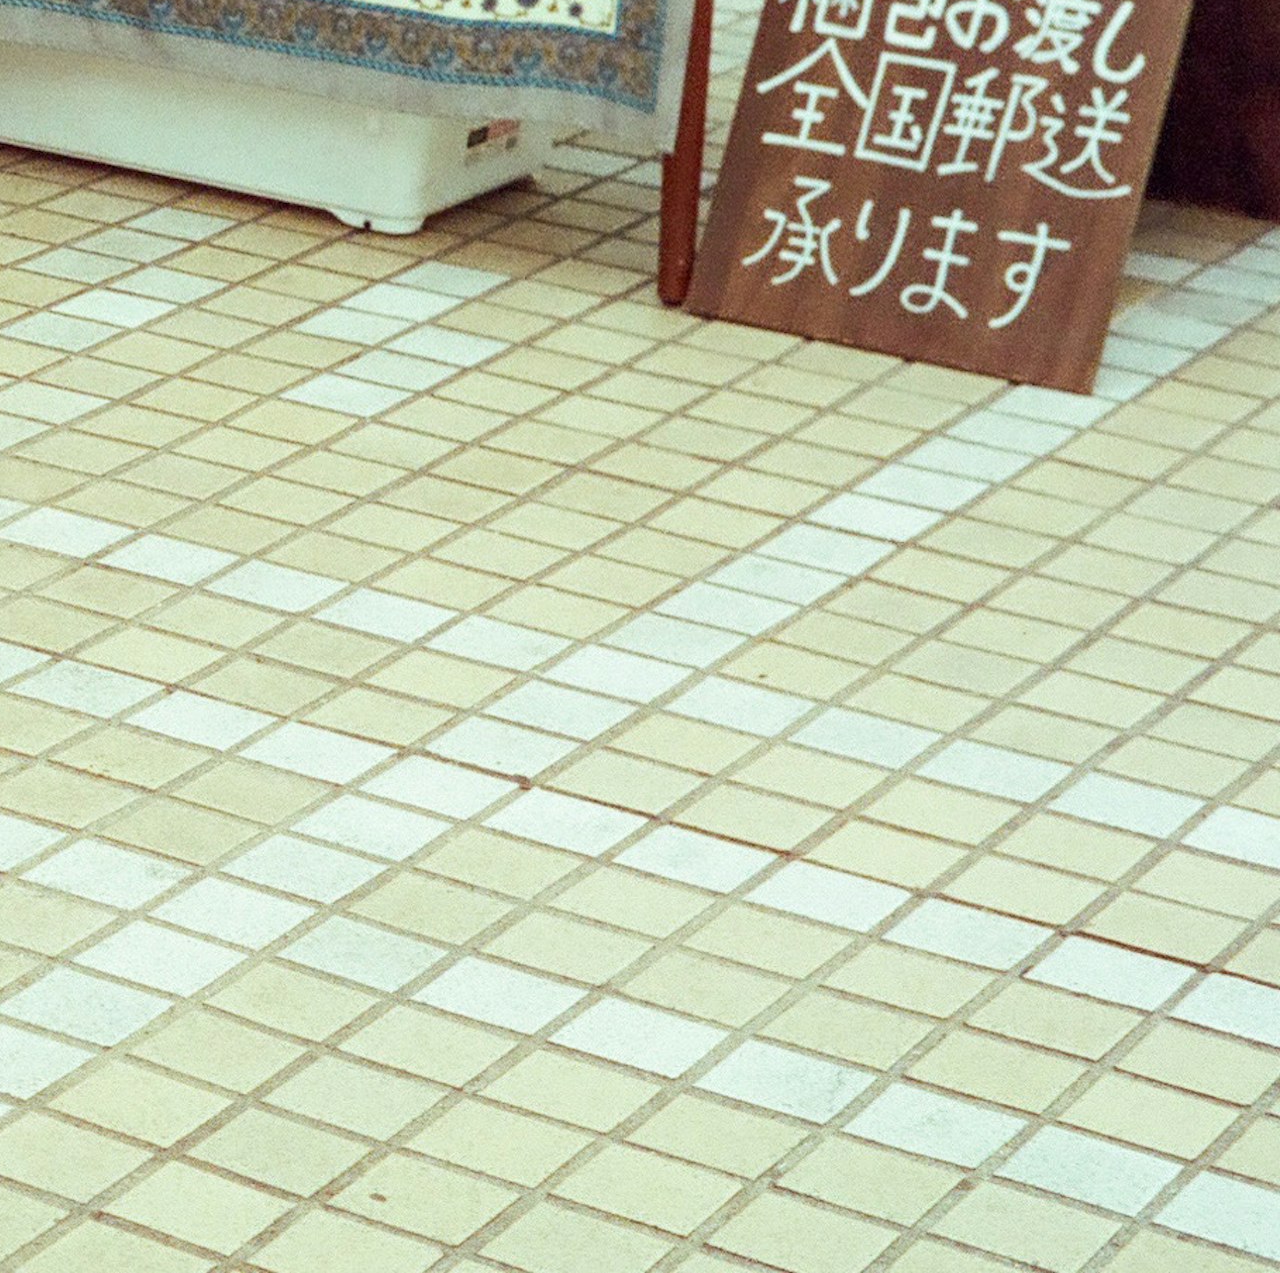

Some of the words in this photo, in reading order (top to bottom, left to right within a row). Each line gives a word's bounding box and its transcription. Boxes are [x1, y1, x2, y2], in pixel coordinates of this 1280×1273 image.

[756, 38, 1133, 200] 全国郵送
[742, 175, 1072, 330] 承ります
